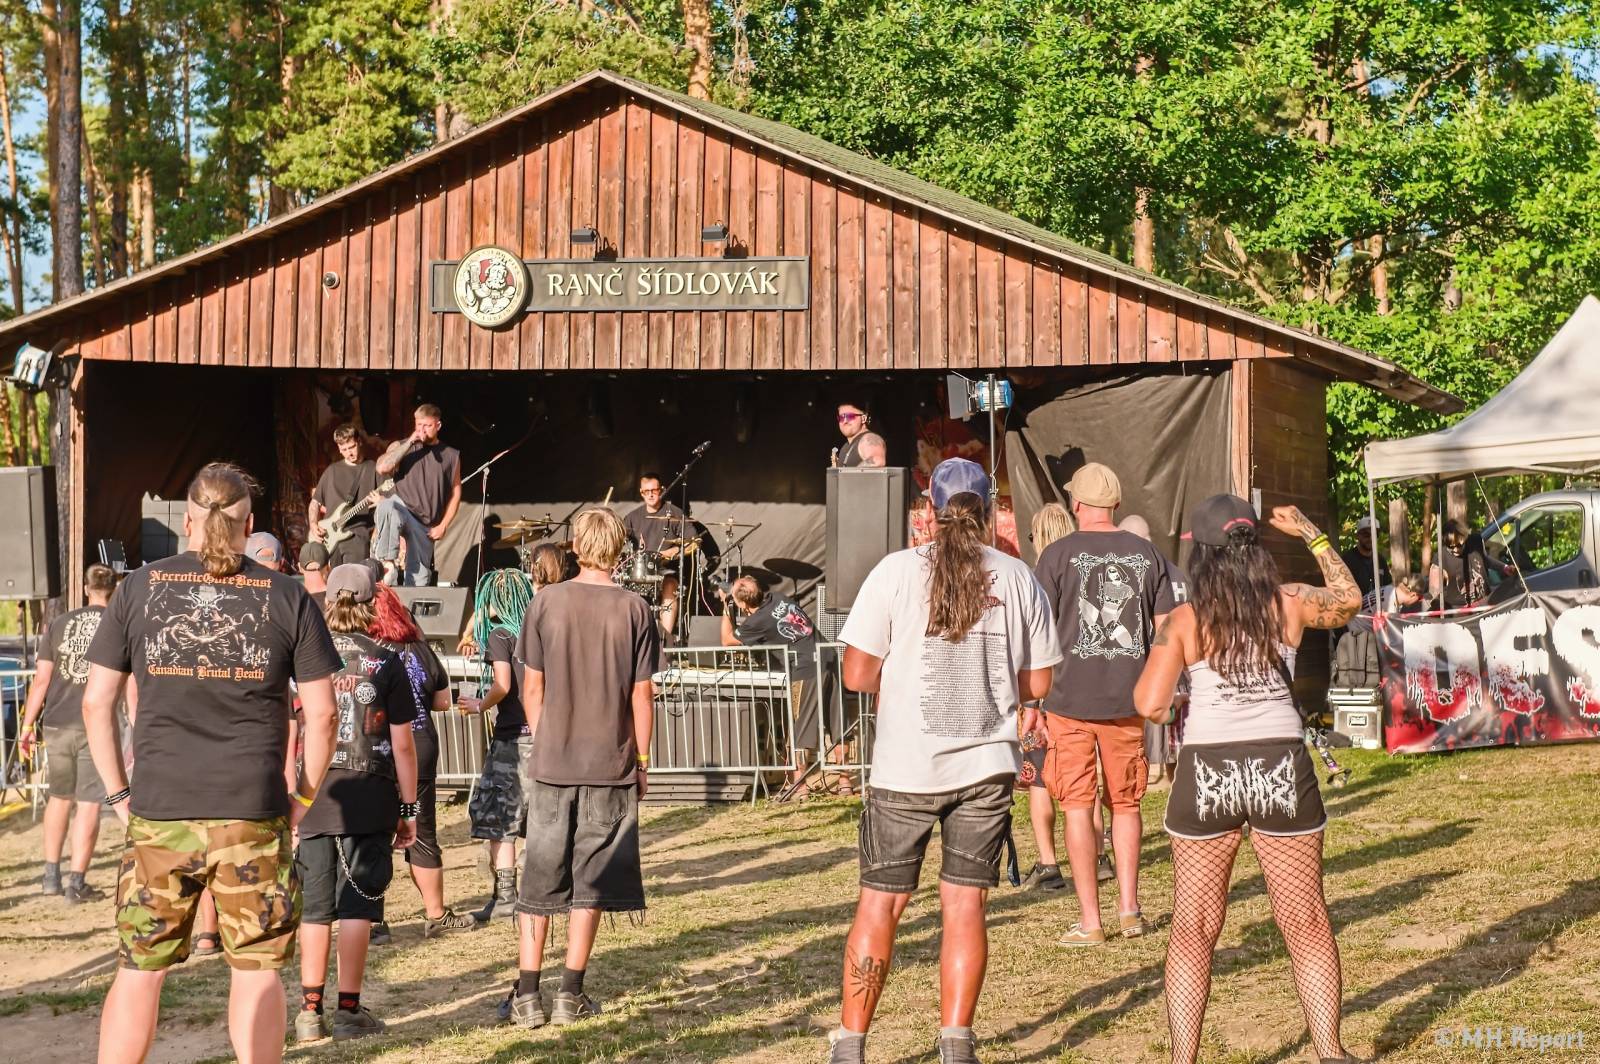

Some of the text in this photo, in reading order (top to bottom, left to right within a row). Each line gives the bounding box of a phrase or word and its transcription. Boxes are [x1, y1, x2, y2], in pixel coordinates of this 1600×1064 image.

[547, 266, 780, 297] RANČ ŠÍDLOVÁK
[148, 664, 265, 681] Canadian Brutal Death
